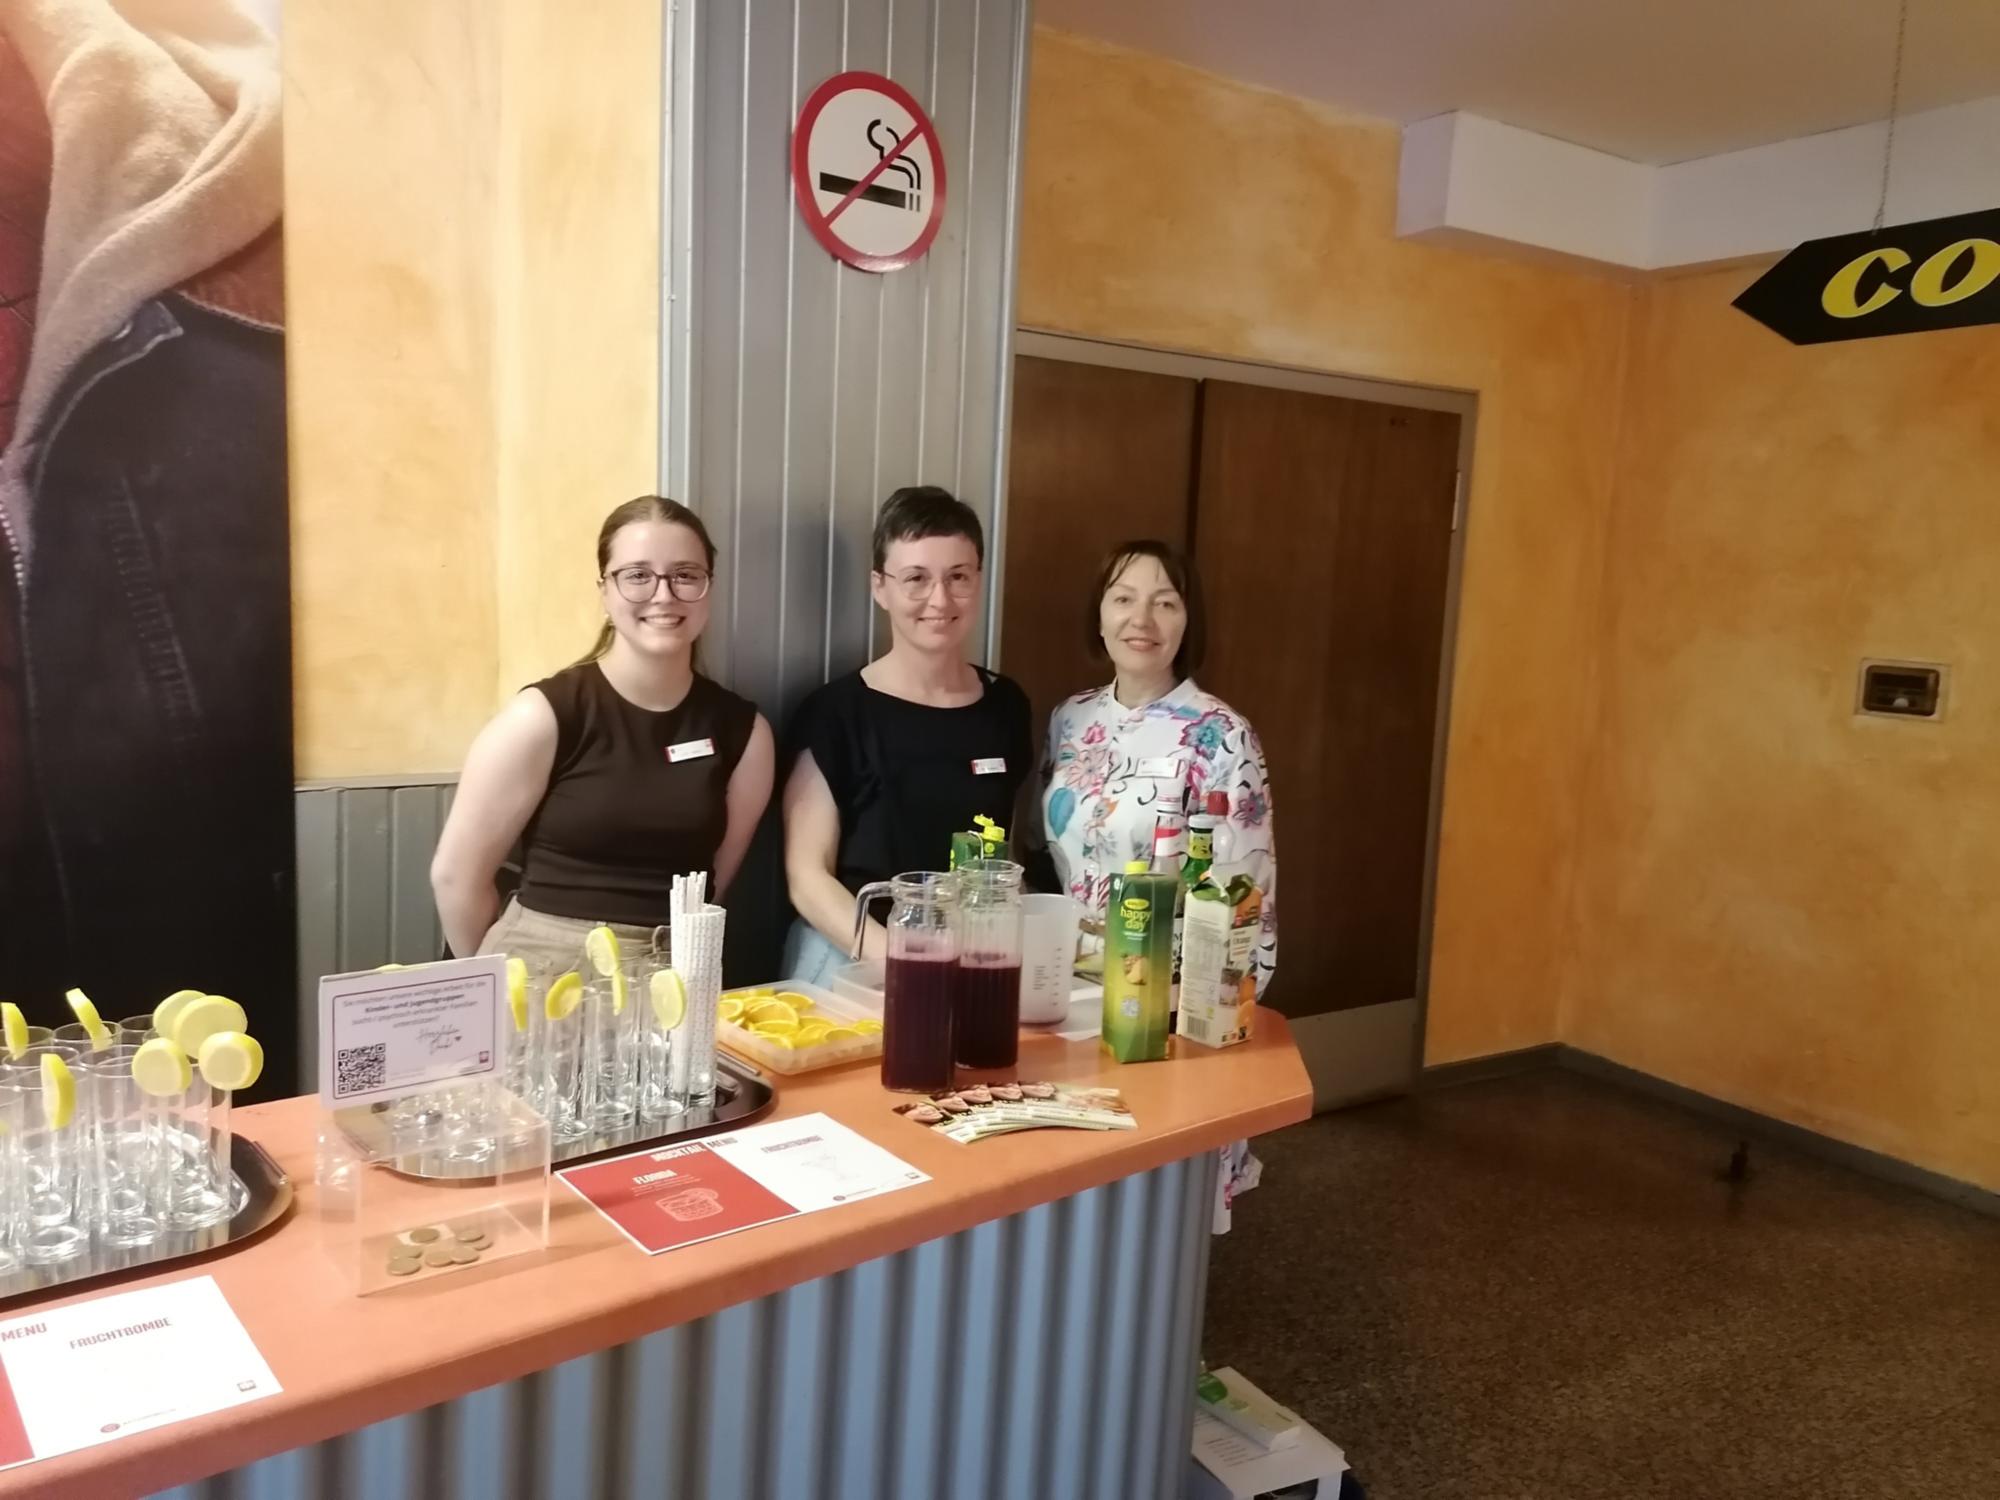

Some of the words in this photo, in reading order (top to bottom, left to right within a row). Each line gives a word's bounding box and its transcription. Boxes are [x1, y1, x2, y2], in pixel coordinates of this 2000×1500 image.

[1120, 905, 1152, 922] happy
[1125, 919, 1147, 932] day
[1, 1322, 48, 1342] MENU
[69, 1316, 173, 1350] FRUCHTBOMBE
